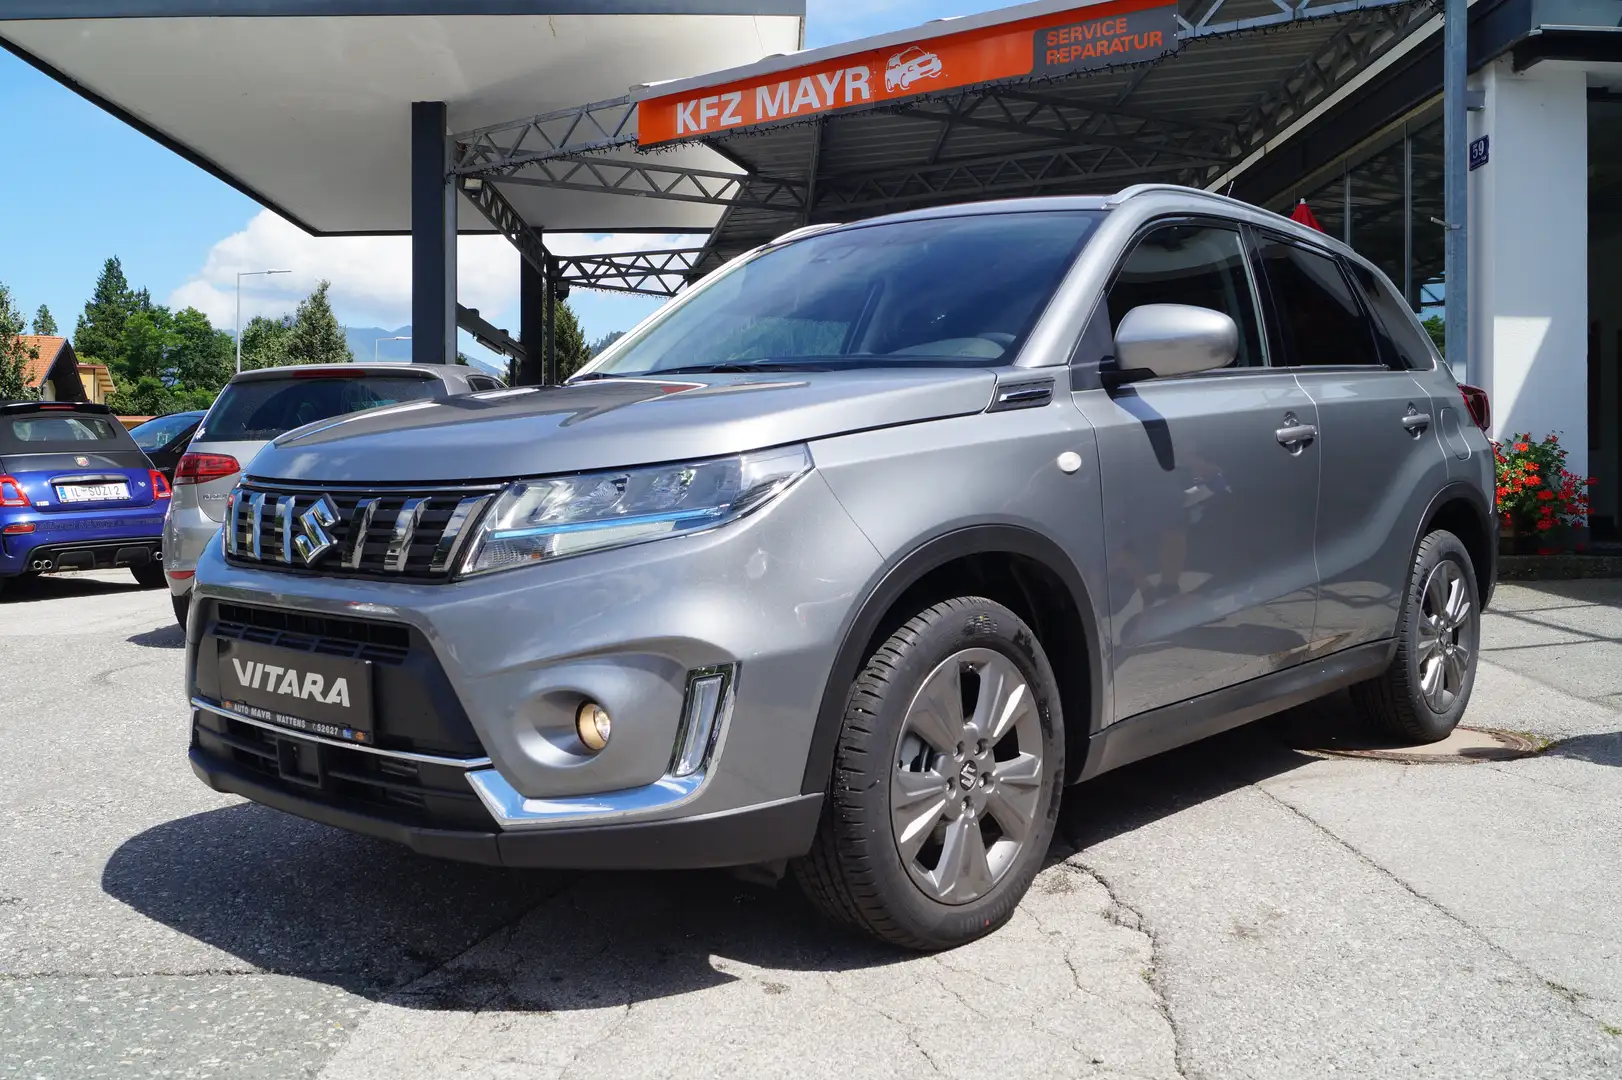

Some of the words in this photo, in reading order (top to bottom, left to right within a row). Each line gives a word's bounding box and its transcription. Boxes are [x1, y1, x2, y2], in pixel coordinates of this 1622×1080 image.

[1046, 18, 1127, 47] SERVICE
[1046, 31, 1163, 65] REPARATUR
[676, 91, 742, 134] KFZ
[755, 65, 870, 120] MAYR
[1472, 140, 1484, 159] 59
[232, 657, 350, 708] VITARA
[234, 704, 249, 714] AUTO
[251, 709, 271, 720] MAYR
[276, 714, 306, 728] WATTENS
